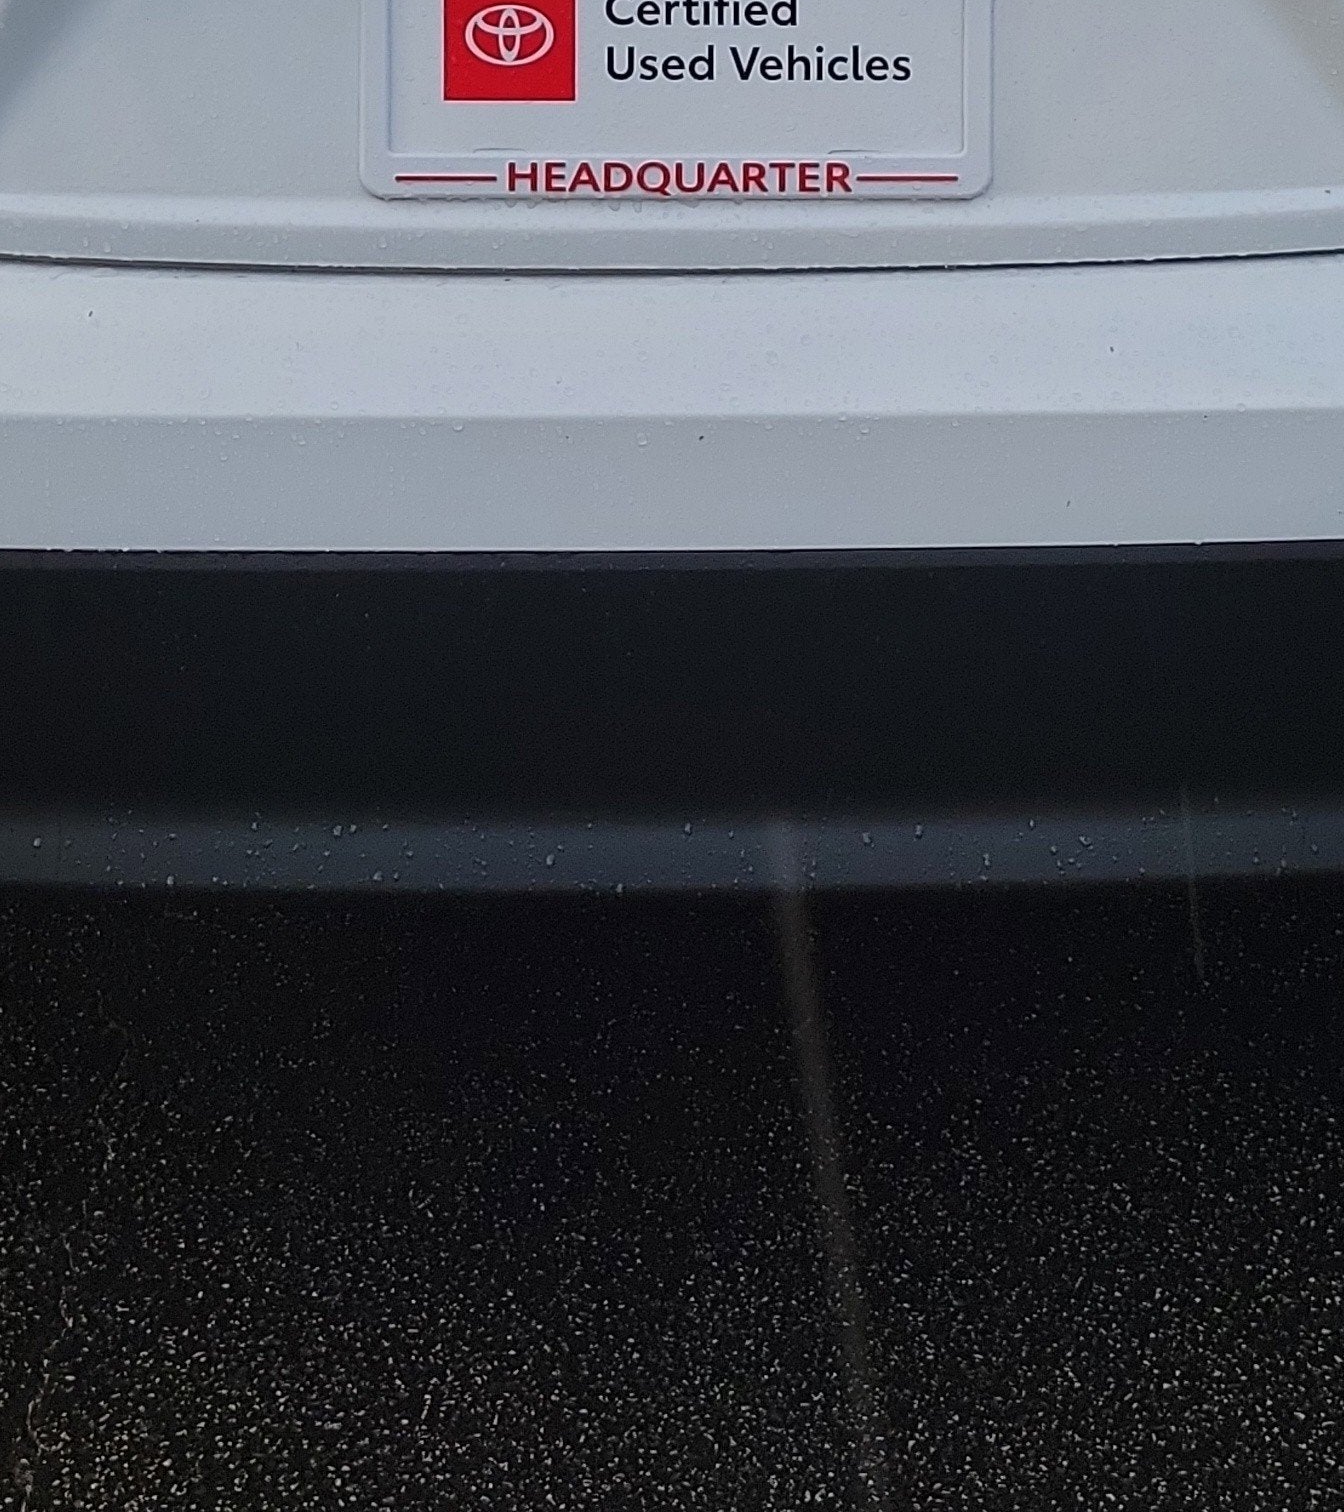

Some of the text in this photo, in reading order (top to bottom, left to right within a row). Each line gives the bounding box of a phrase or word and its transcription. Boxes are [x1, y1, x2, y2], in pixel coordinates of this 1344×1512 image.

[606, 45, 912, 82] Used Vehicles
[507, 162, 853, 196] HEADQUARTER
